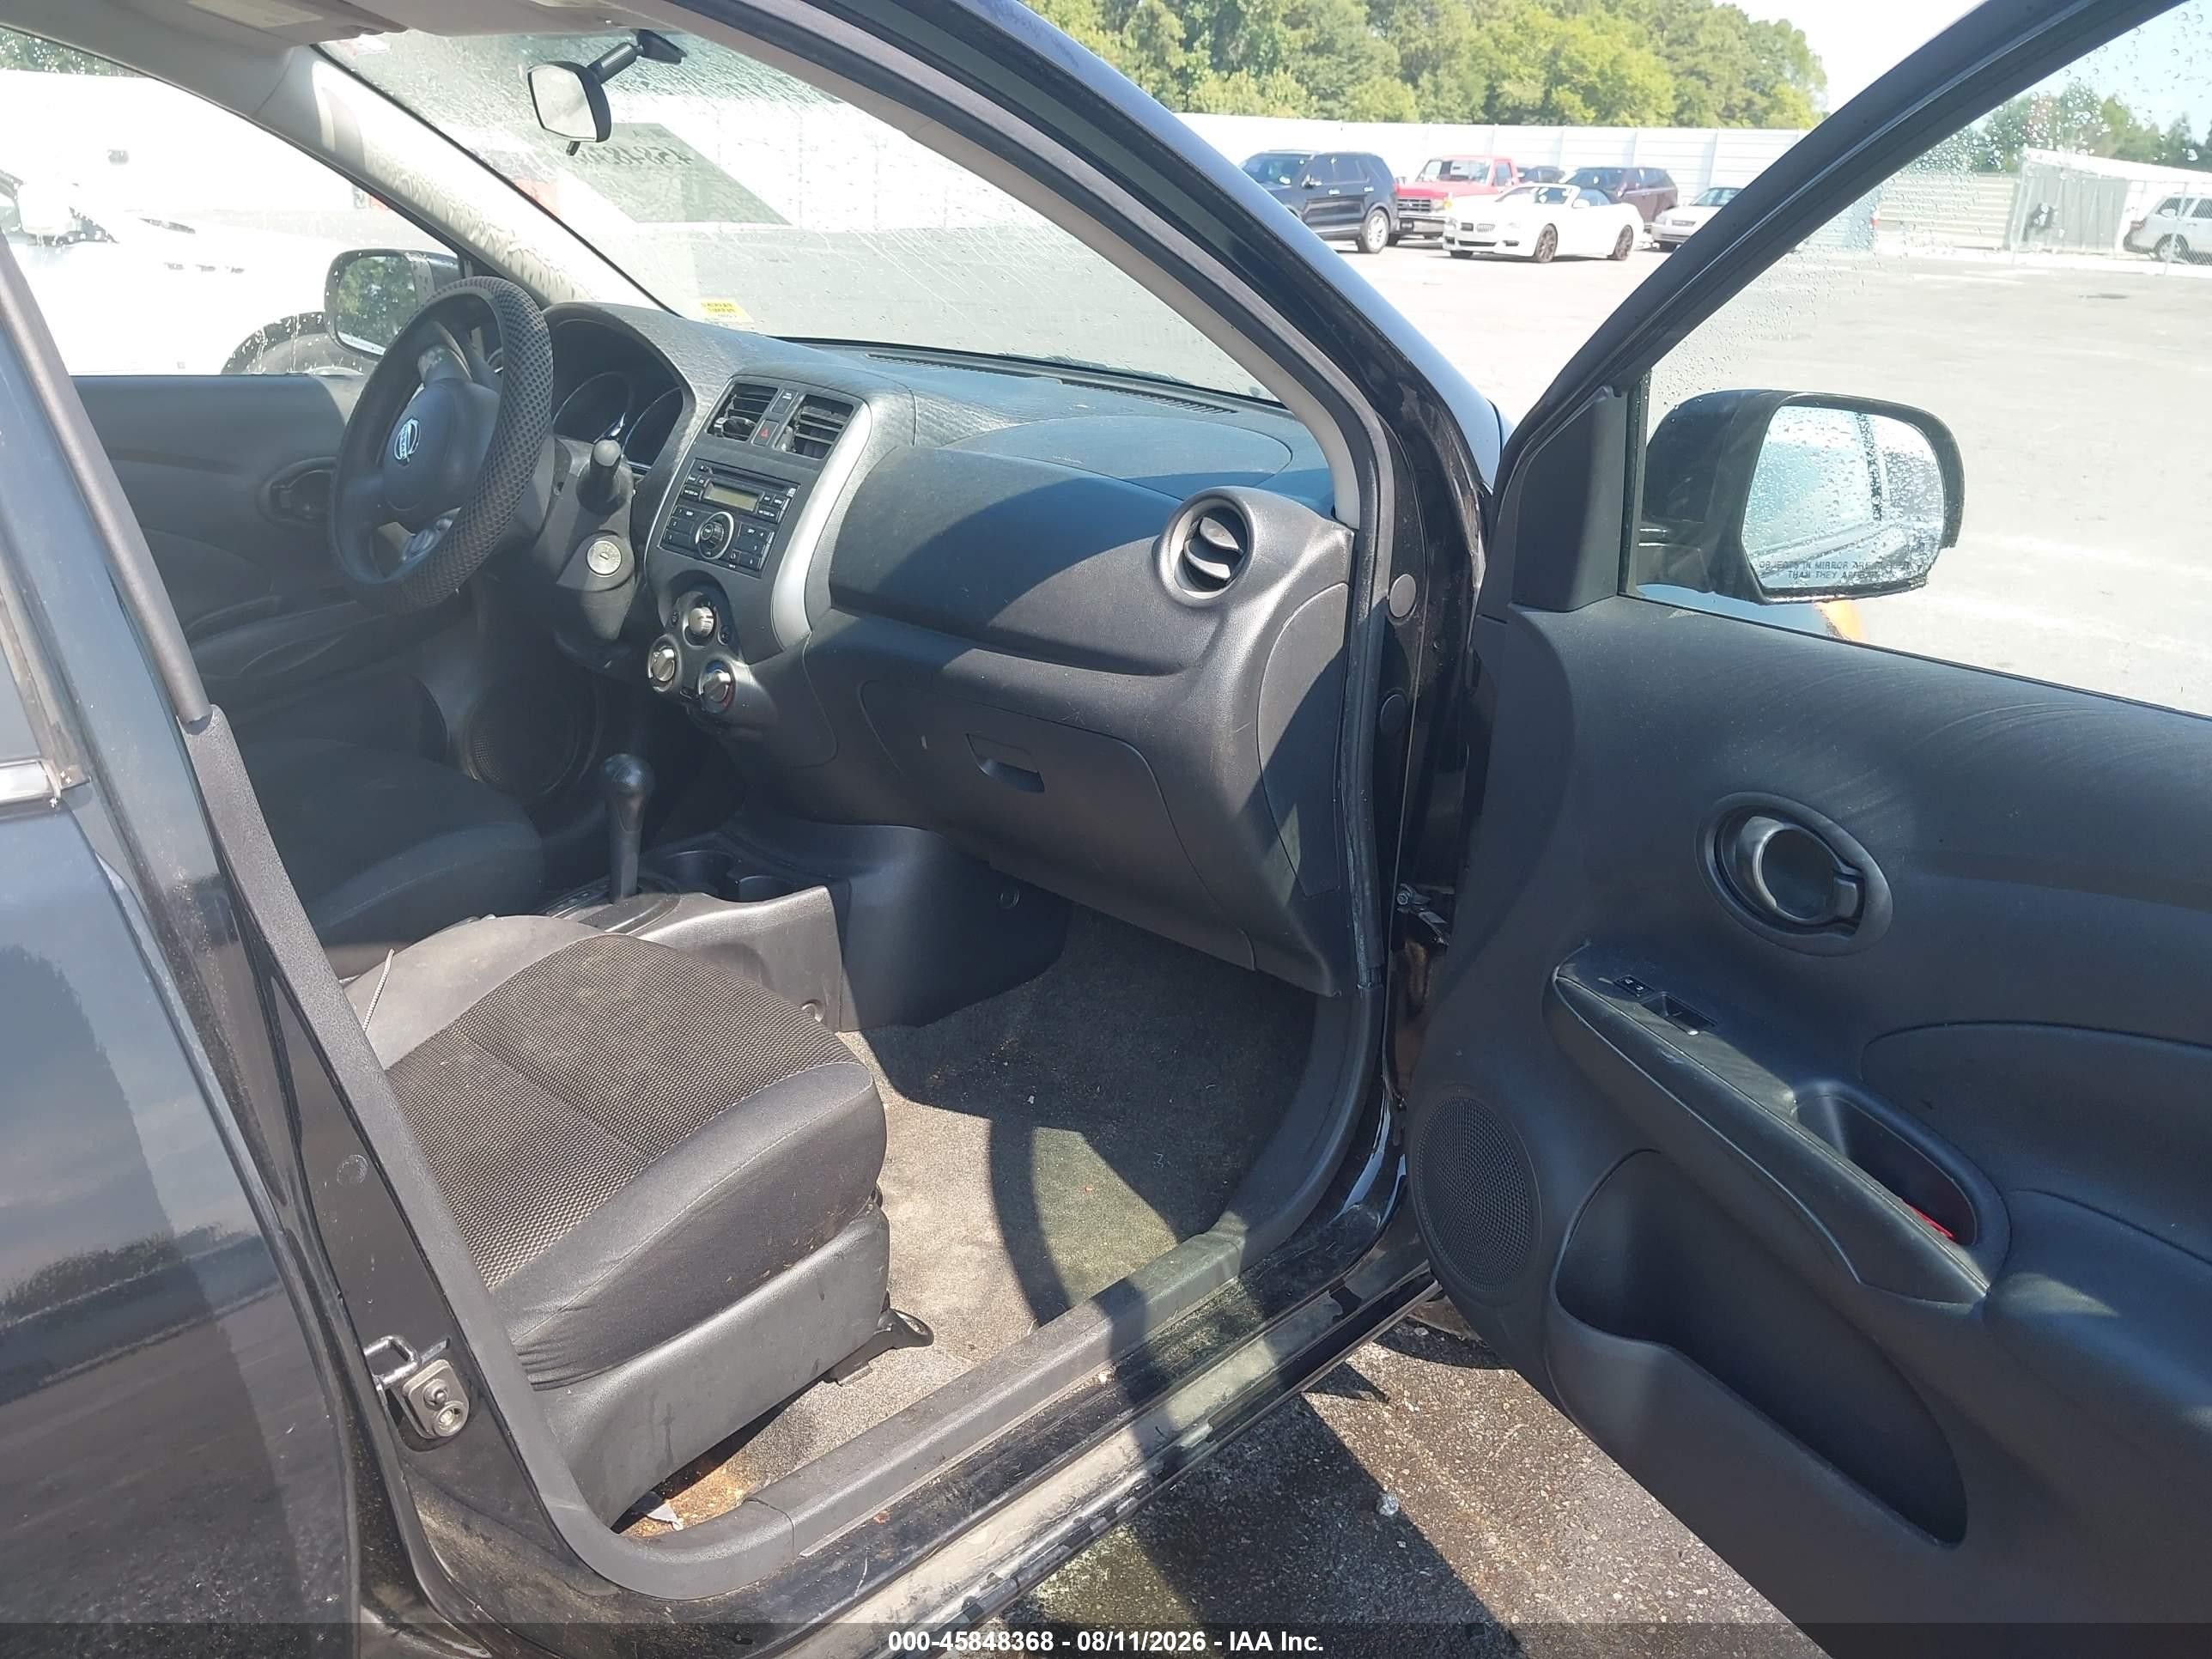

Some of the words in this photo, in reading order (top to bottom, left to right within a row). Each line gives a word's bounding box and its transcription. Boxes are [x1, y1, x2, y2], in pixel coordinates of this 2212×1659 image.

[1759, 561, 1800, 570] OBJECTS
[1803, 561, 1812, 570] IN
[1814, 561, 1848, 570] MIRROR
[1787, 570, 1811, 580] THAN
[1814, 570, 1838, 579] THEY
